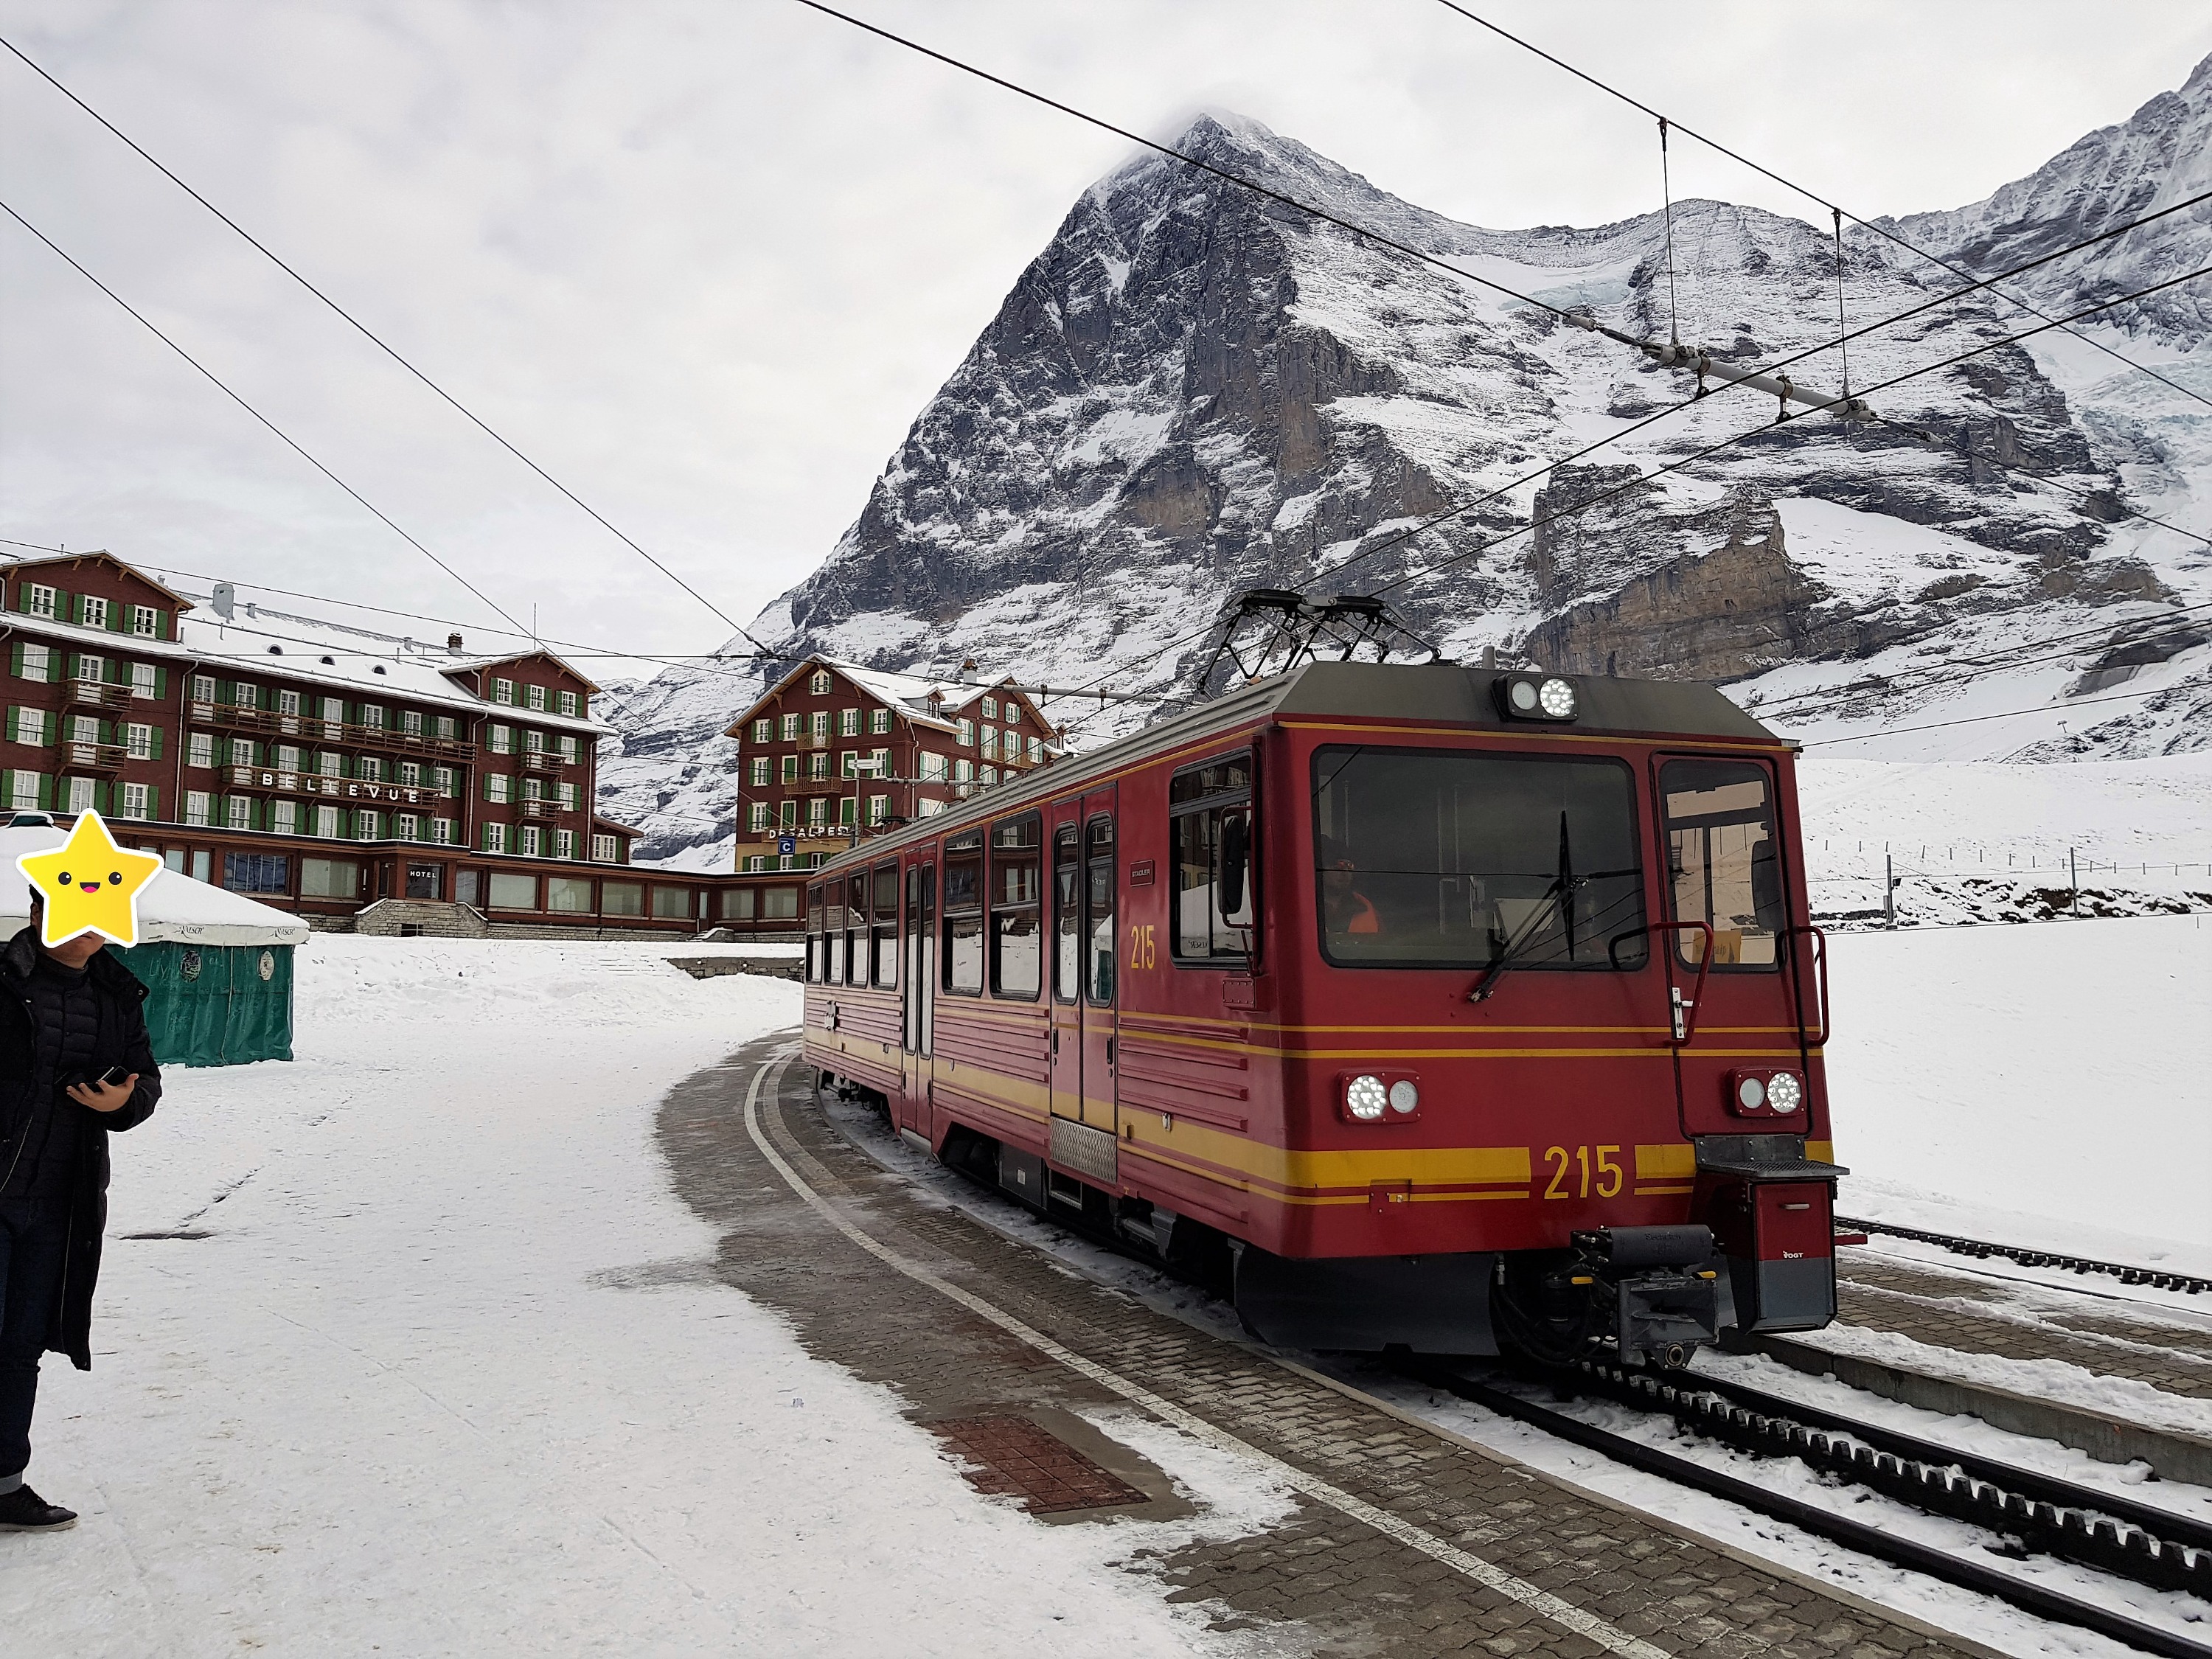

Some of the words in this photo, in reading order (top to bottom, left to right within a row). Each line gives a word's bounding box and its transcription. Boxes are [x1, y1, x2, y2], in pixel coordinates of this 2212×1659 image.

[262, 773, 417, 803] BELLEVUE
[782, 842, 791, 852] C
[1132, 869, 1150, 877] STADLER
[1130, 925, 1155, 970] 215
[1543, 1144, 1624, 1200] 215
[1783, 1251, 1804, 1259] VOGT
